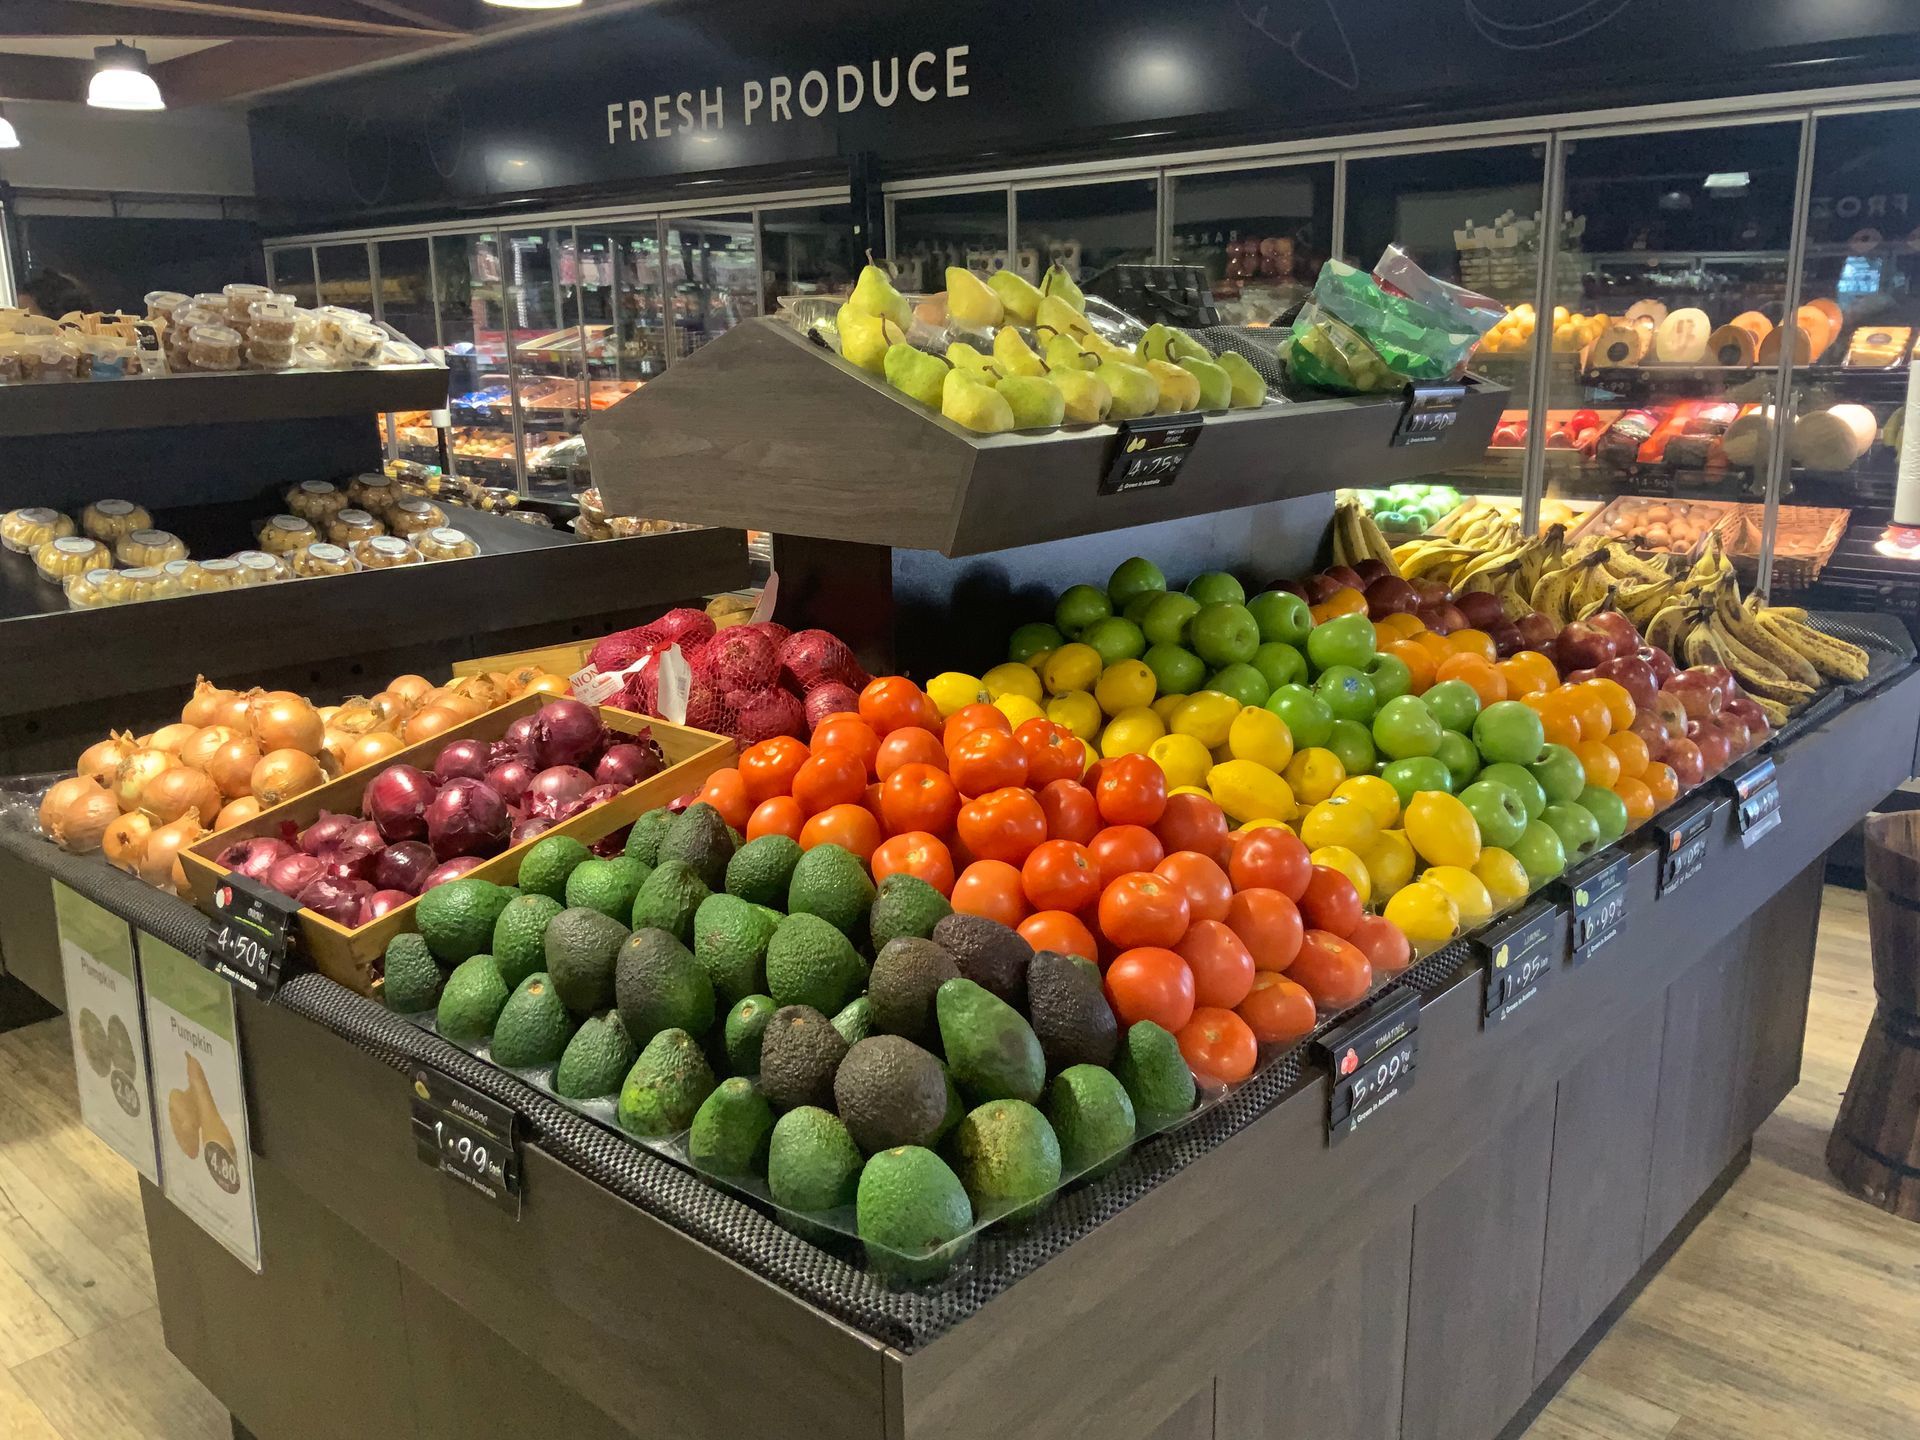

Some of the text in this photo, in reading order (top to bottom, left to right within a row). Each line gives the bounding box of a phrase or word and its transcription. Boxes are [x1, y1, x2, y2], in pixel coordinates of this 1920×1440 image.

[607, 44, 970, 144] FRESH PRODUCE
[1128, 456, 1172, 476] 4.75
[1586, 901, 1616, 940] 6.99
[217, 926, 258, 968] 4.50
[1508, 955, 1540, 998] 1.95
[170, 1015, 213, 1057] Pumpkin
[1353, 1055, 1400, 1110] 5.99
[435, 1120, 487, 1173] 1.99
